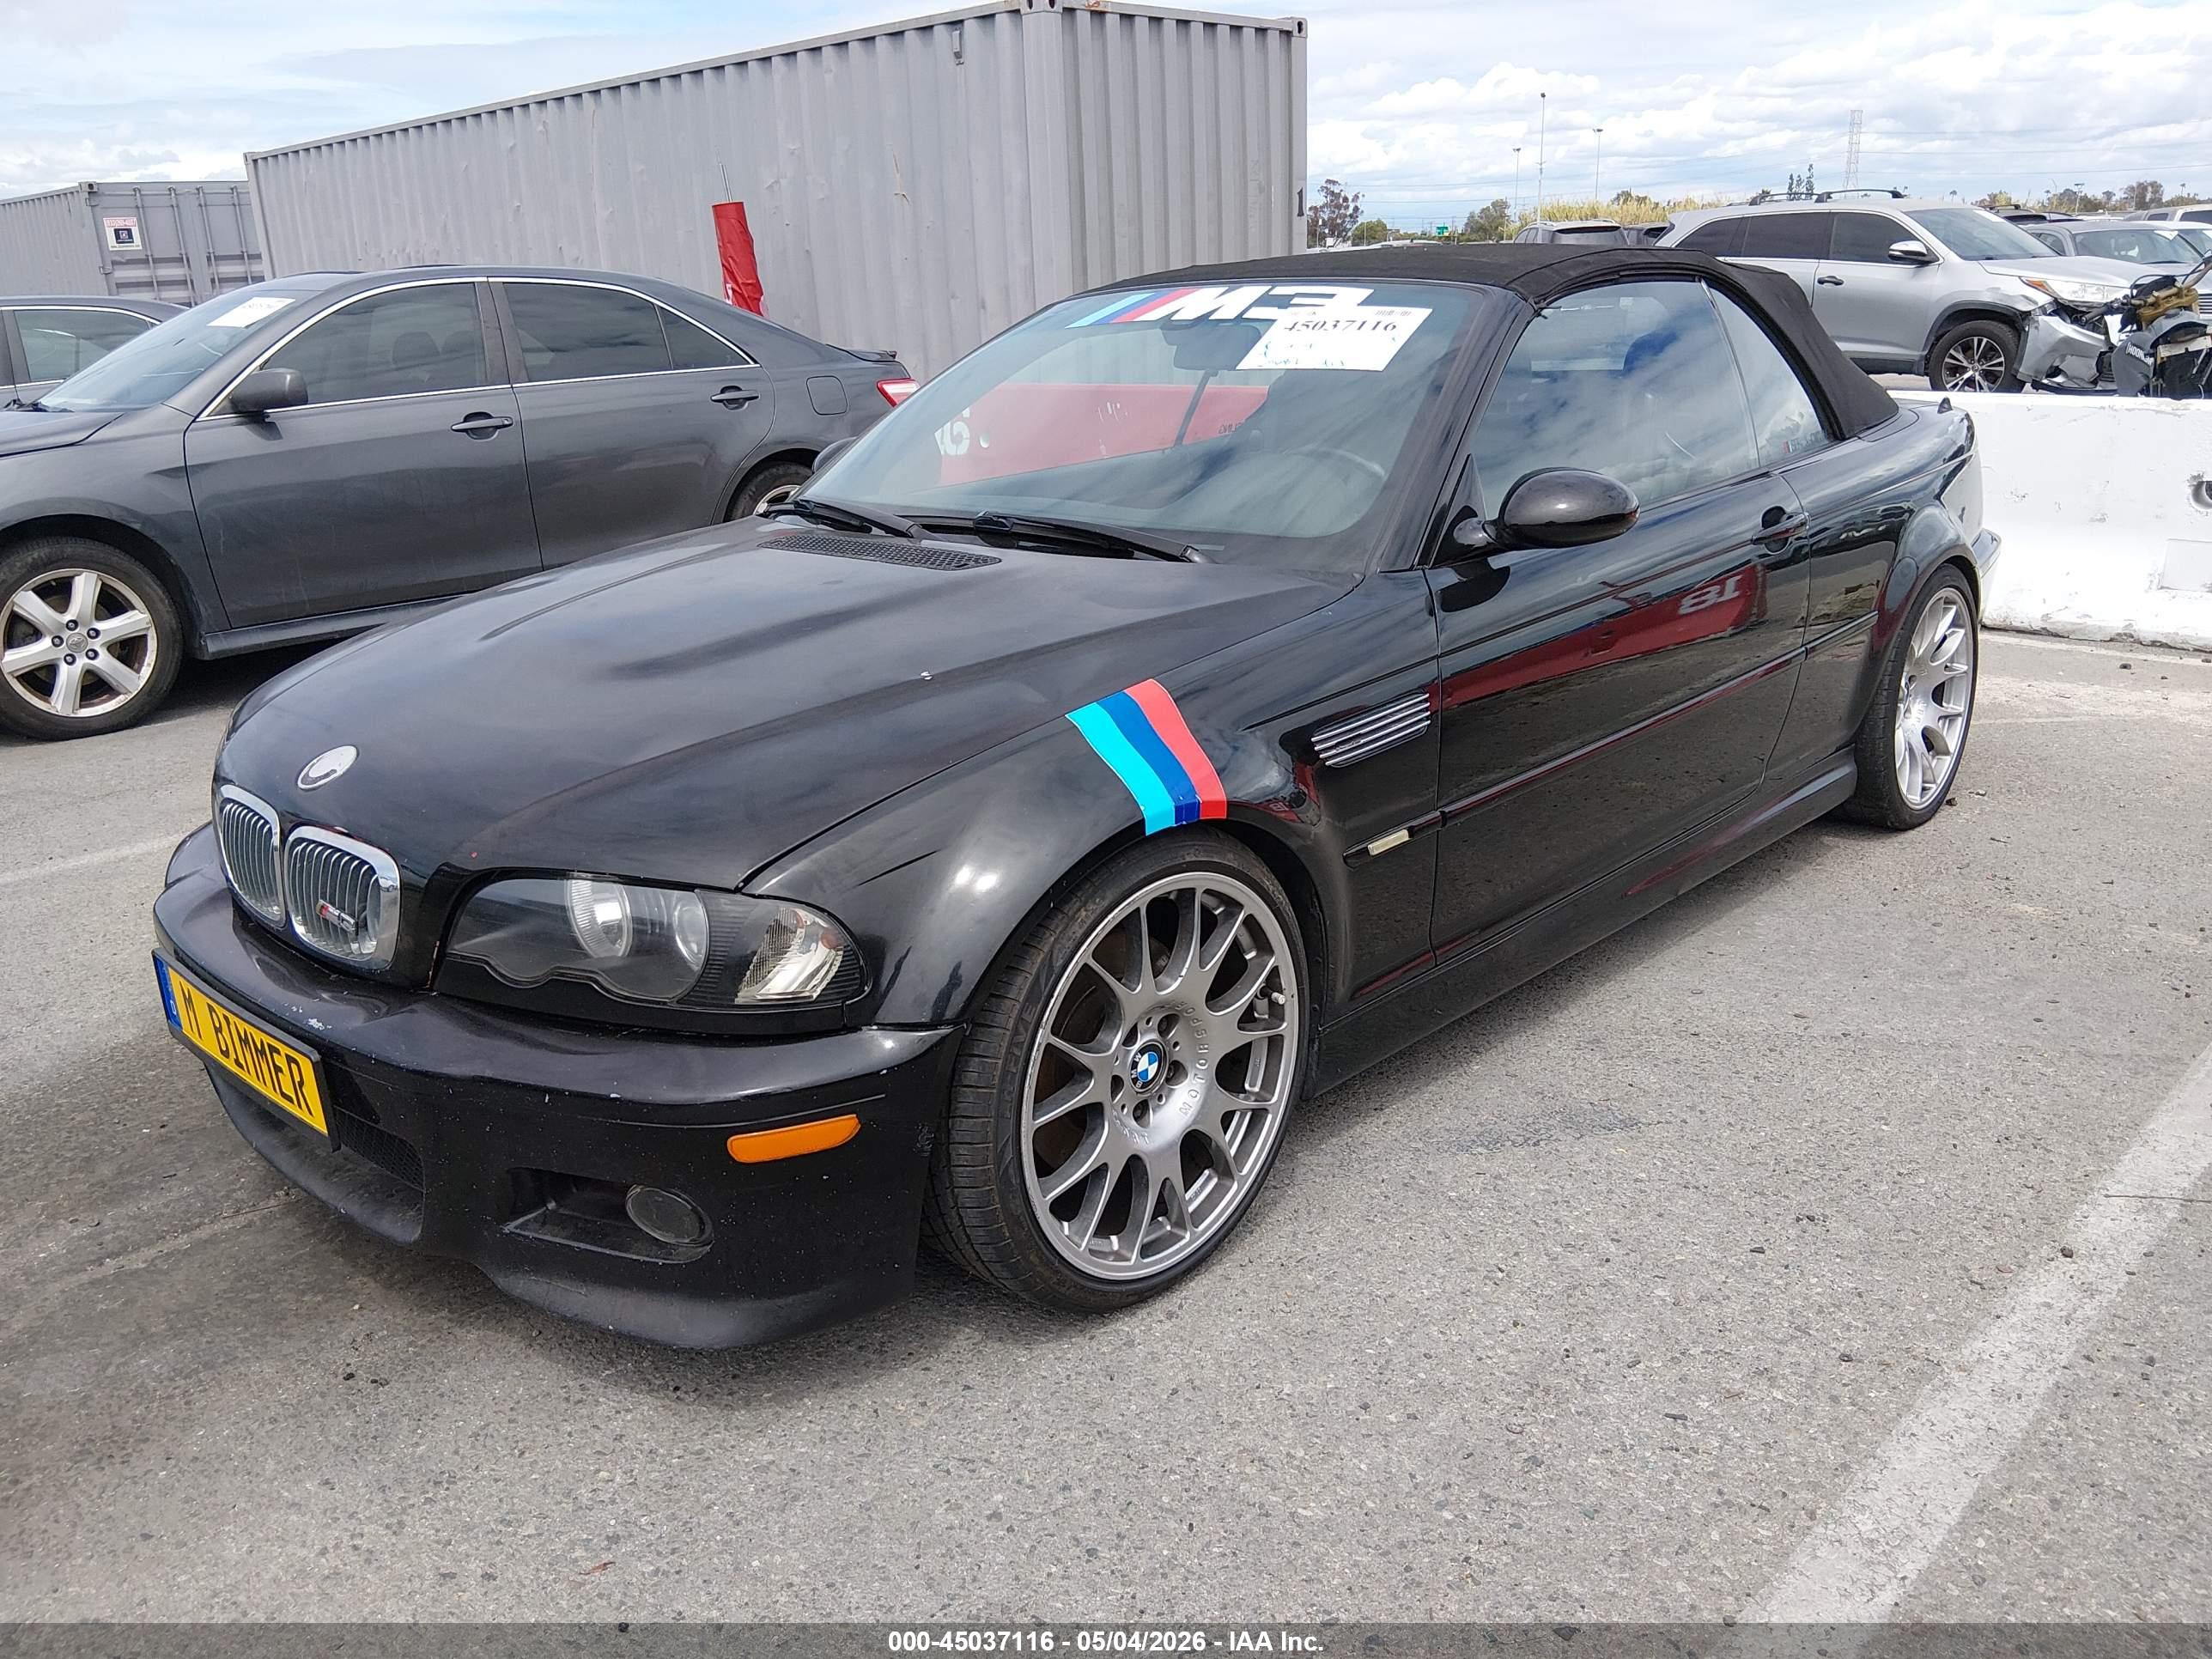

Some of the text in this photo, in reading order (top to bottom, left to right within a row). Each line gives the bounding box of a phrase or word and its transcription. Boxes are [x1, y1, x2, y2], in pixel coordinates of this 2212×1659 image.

[1134, 285, 1375, 322] M3
[1284, 319, 1397, 331] 45037116
[179, 981, 314, 1117] M BIMMER
[1173, 1000, 1209, 1117] MOTORSPOR
[1130, 1052, 1143, 1088] BMW
